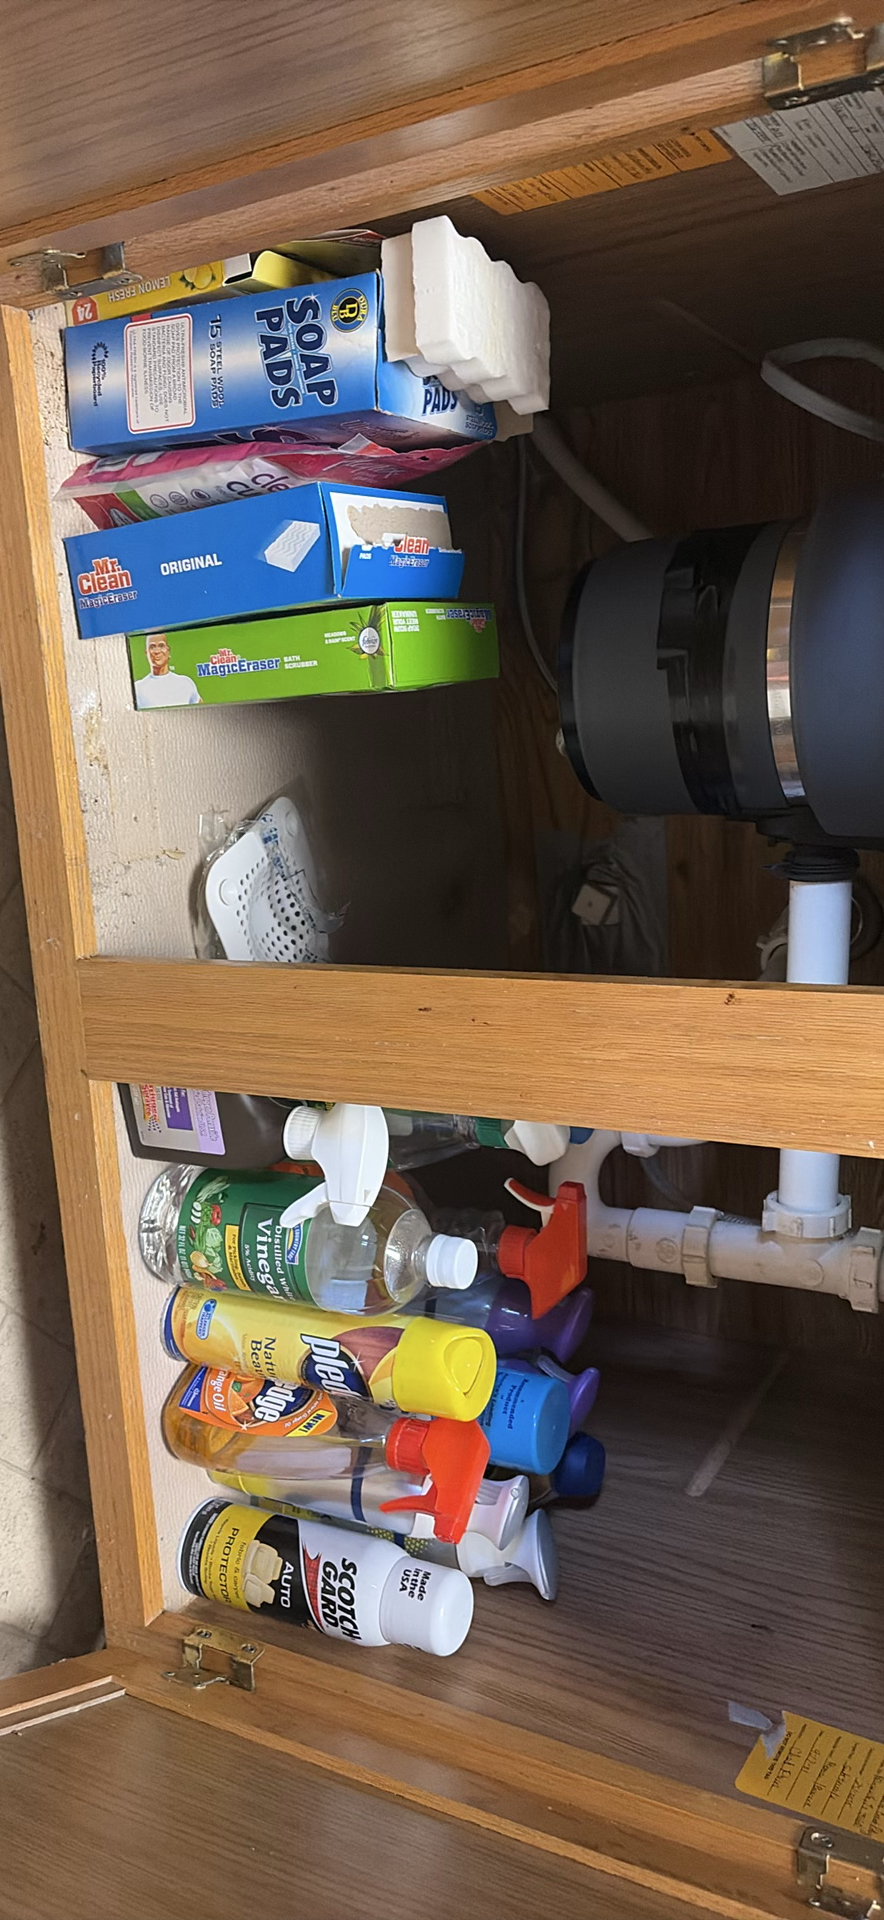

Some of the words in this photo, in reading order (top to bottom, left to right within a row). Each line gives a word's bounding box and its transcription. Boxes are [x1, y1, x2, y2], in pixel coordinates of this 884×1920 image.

[108, 287, 137, 302] FRESH
[139, 276, 171, 292] LEMON
[77, 304, 92, 321] 24
[358, 295, 367, 322] DURA
[210, 314, 222, 339] 15
[256, 307, 301, 408] PADS
[286, 298, 337, 406] SOAP
[422, 387, 457, 415] PADS
[92, 557, 121, 576] Mr.
[160, 554, 222, 576] ORIGINAL
[389, 555, 430, 567] MagicEraser
[78, 570, 132, 595] Clean
[79, 591, 138, 608] MagicEraser
[218, 648, 233, 656] Mr.
[196, 658, 280, 677] MagicEraser
[285, 661, 318, 669] SCRUBBER
[205, 1114, 218, 1142] Peroxide
[244, 1244, 250, 1256] 5%
[256, 1218, 286, 1301] Vinegar
[246, 1258, 256, 1281] Acidity
[274, 1225, 284, 1274] Distilled
[279, 1278, 295, 1301] White
[202, 1313, 211, 1336] ALLERGEN
[212, 1393, 226, 1412] Oil
[502, 1384, 516, 1415] Product
[508, 1379, 529, 1429] Recommended
[298, 1413, 325, 1433] NEW!
[210, 1536, 220, 1555] Liquids
[235, 1542, 246, 1565] fabric
[219, 1528, 240, 1603] PROTECTOR
[280, 1561, 294, 1608] AUTO
[399, 1569, 412, 1592] USA
[408, 1582, 419, 1598] the
[417, 1571, 432, 1601] Made
[321, 1561, 339, 1627] GARD
[338, 1558, 362, 1640] SCOTCH
